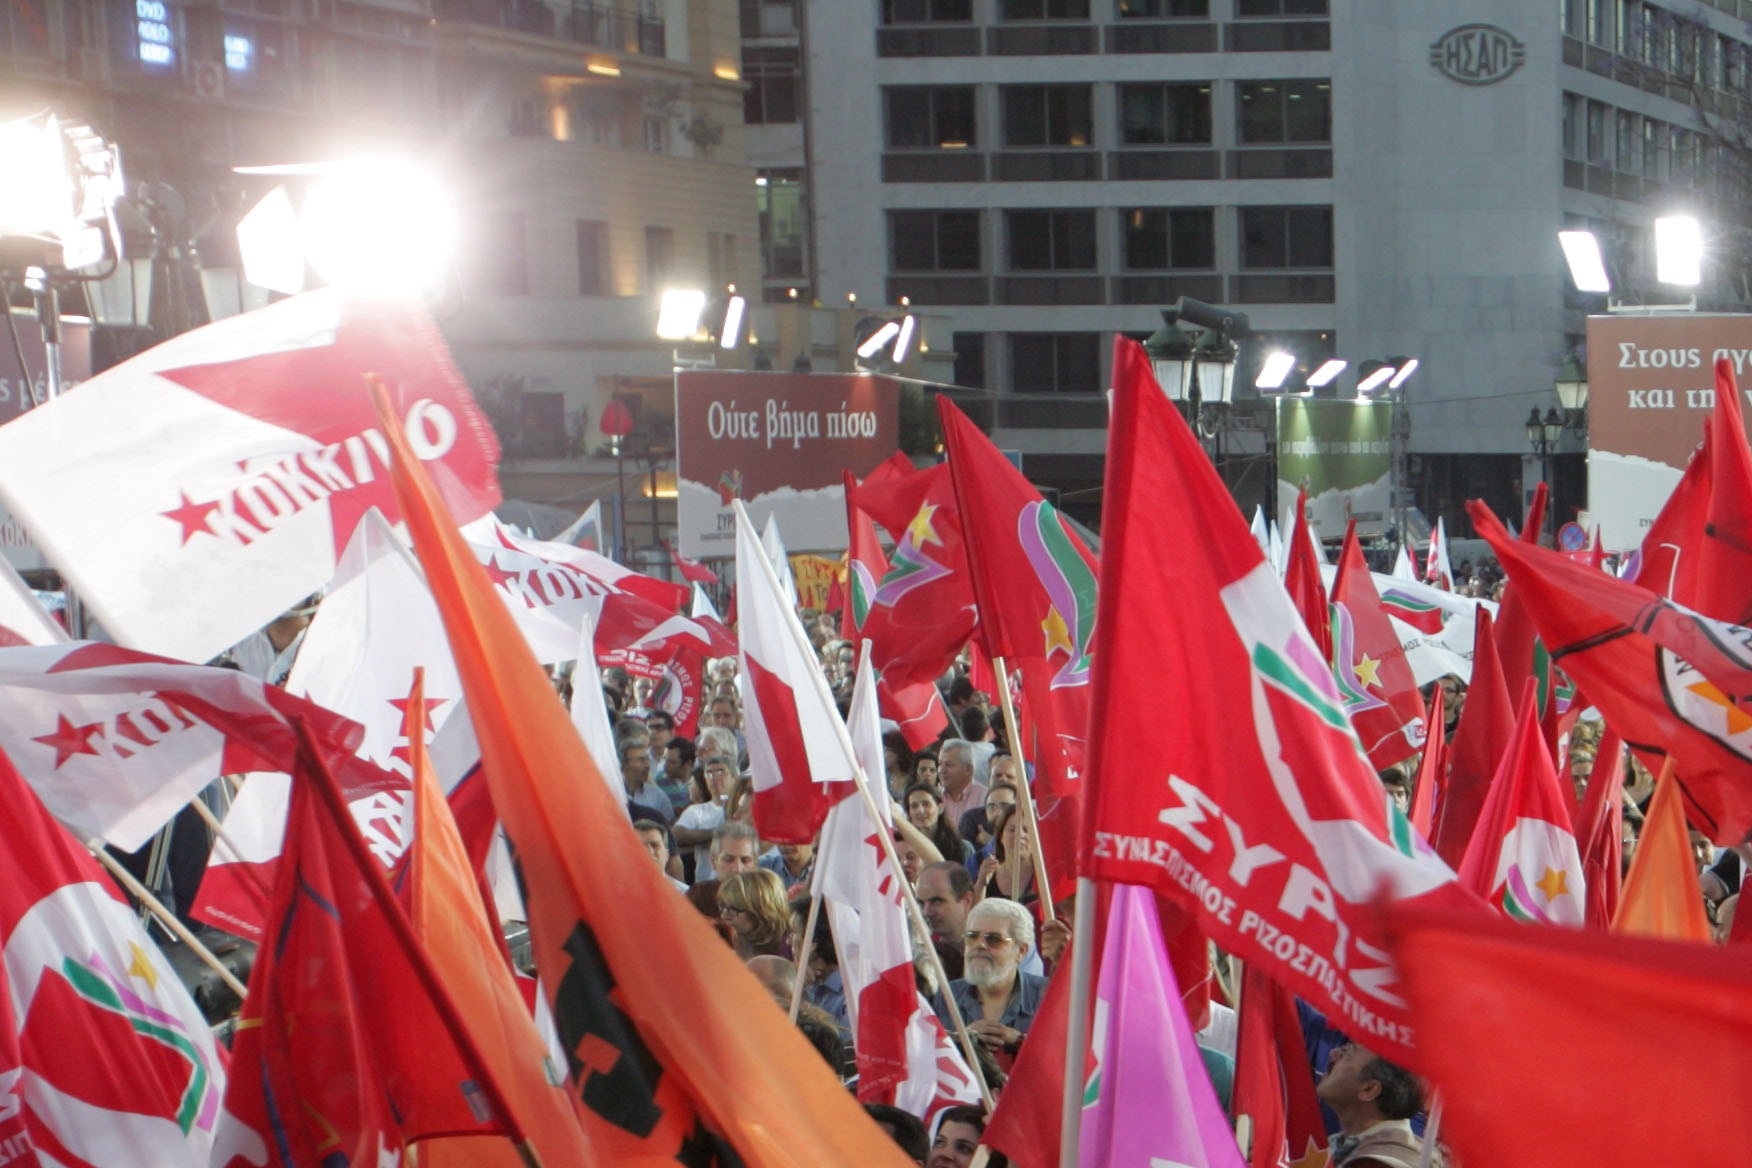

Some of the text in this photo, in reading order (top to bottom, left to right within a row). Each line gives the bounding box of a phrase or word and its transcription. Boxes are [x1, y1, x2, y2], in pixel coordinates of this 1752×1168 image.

[1618, 342, 1701, 368] Στους
[1628, 389, 1675, 409] και
[1686, 389, 1716, 409] τη
[708, 398, 878, 449] Ούτε βήμα πίσω
[1094, 831, 1417, 1049] ΣΥΝΑΣΠΙΣΜΟΣ ΡΙΖΟΣΠΑΣΤΙΚΗΣ
